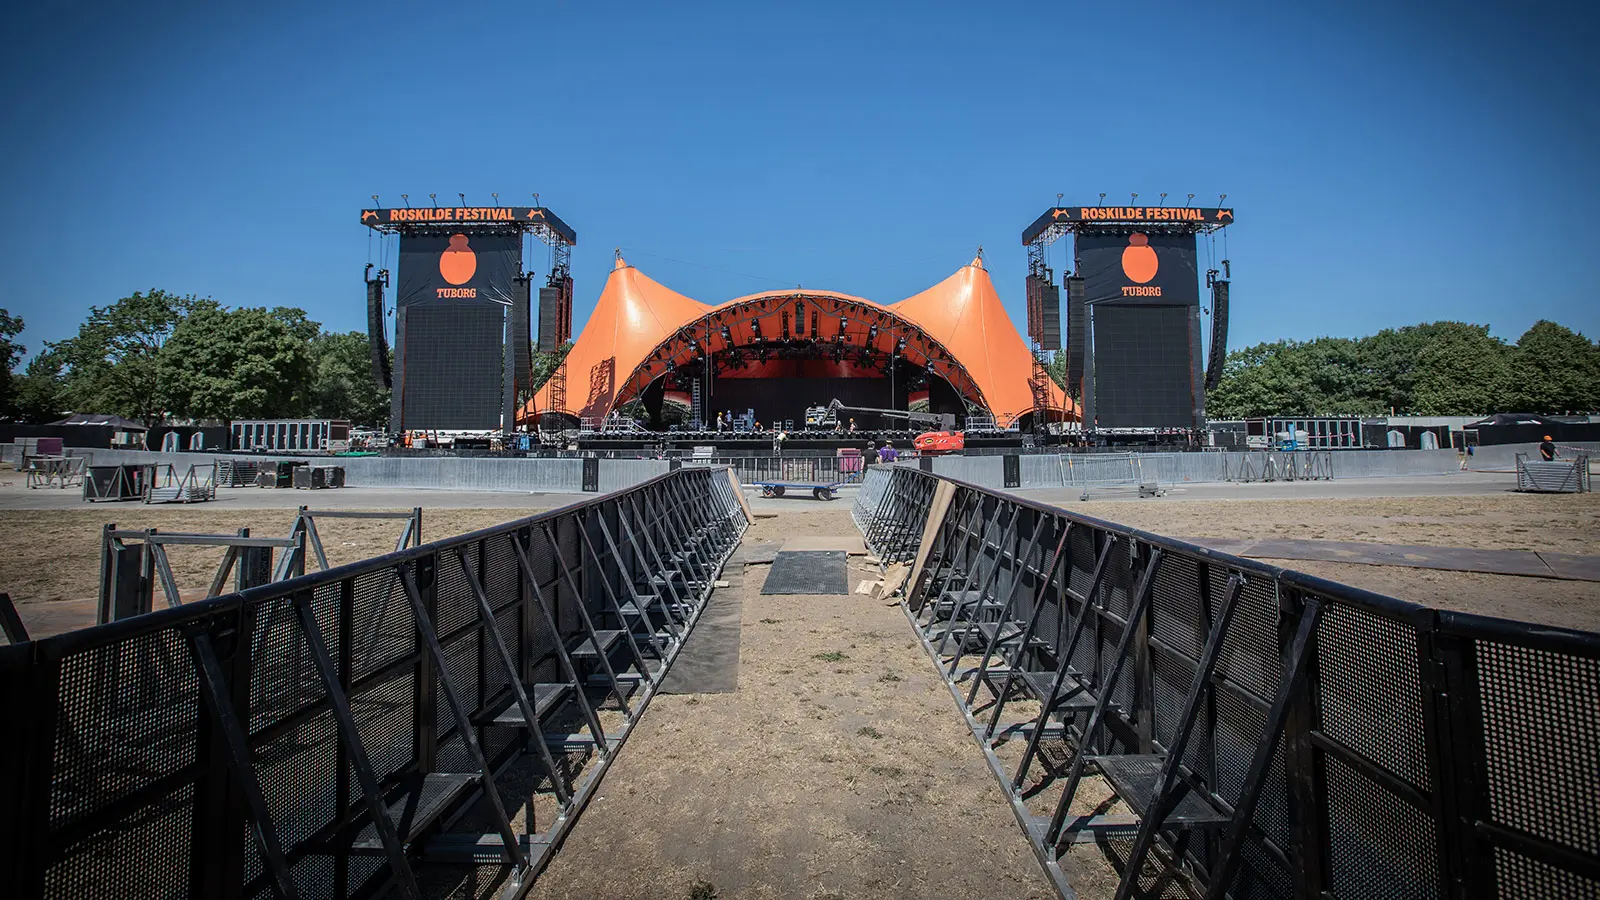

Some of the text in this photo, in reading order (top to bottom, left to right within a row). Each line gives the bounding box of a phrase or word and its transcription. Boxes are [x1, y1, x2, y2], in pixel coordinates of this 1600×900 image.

[390, 208, 515, 221] ROSKILDE FESTIVAL
[1081, 208, 1204, 220] ROSKILDE FESTIVAL
[437, 288, 476, 298] TUBORG
[1122, 286, 1162, 297] TUBORG
